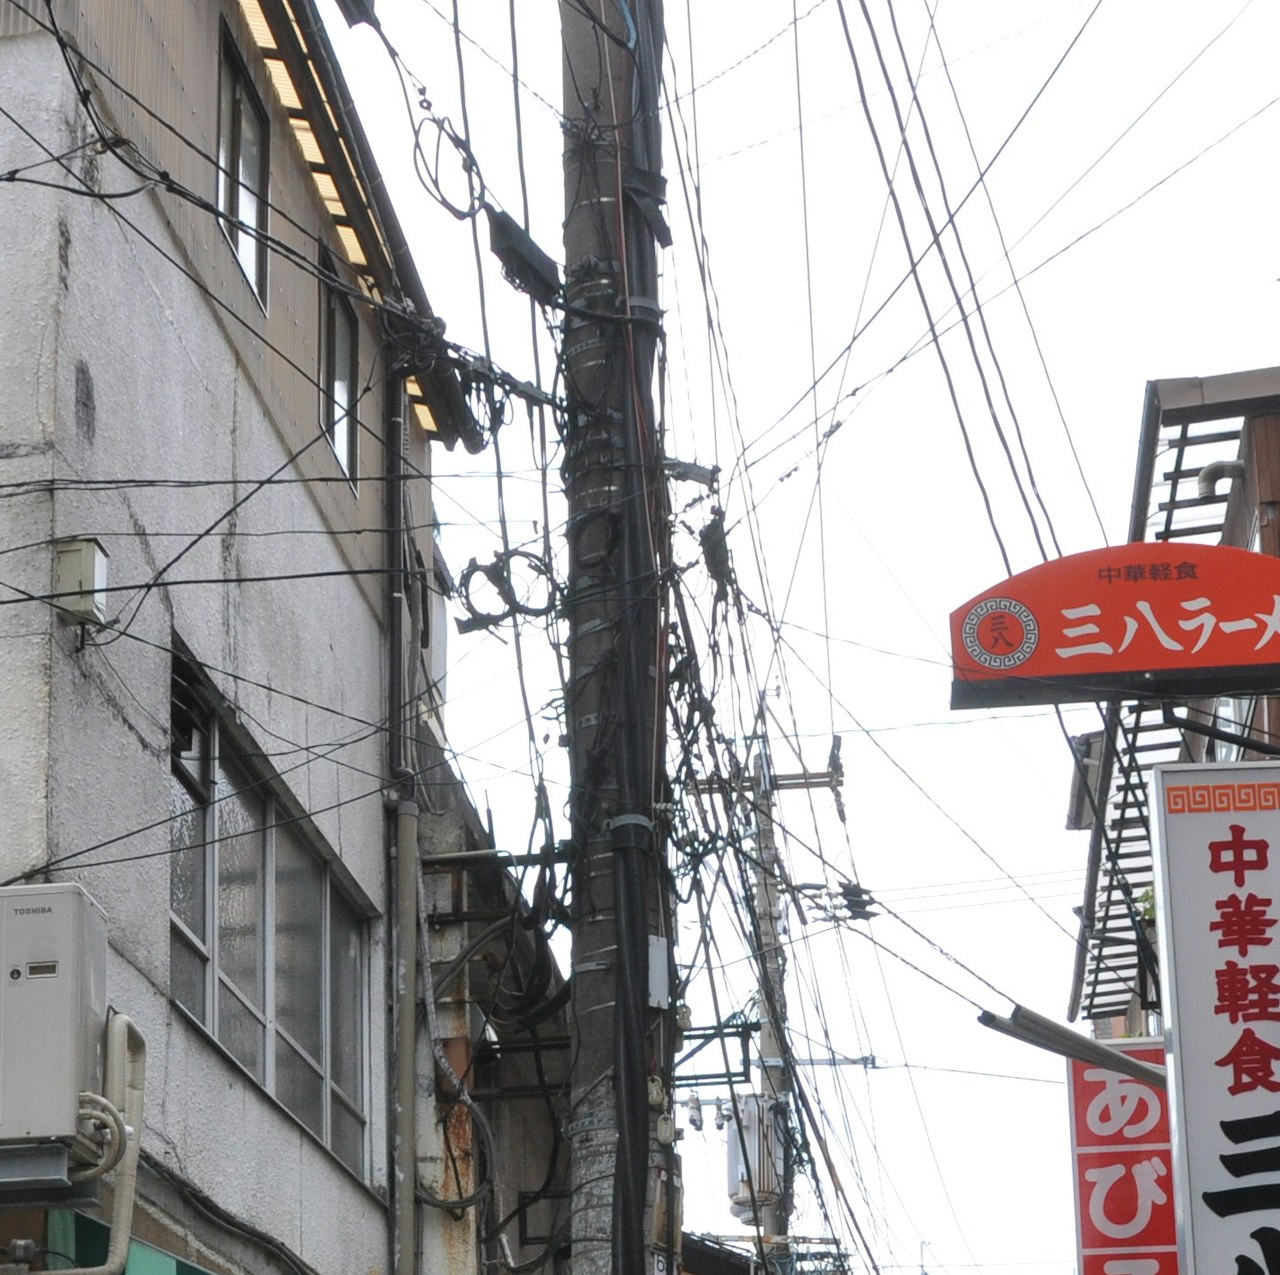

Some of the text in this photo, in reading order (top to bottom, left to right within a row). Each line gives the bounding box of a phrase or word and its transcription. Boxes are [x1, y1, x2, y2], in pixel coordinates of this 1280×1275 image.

[1098, 560, 1199, 585] 中華軽食
[989, 615, 1015, 649] 三八
[13, 906, 54, 917] TOSHIBA
